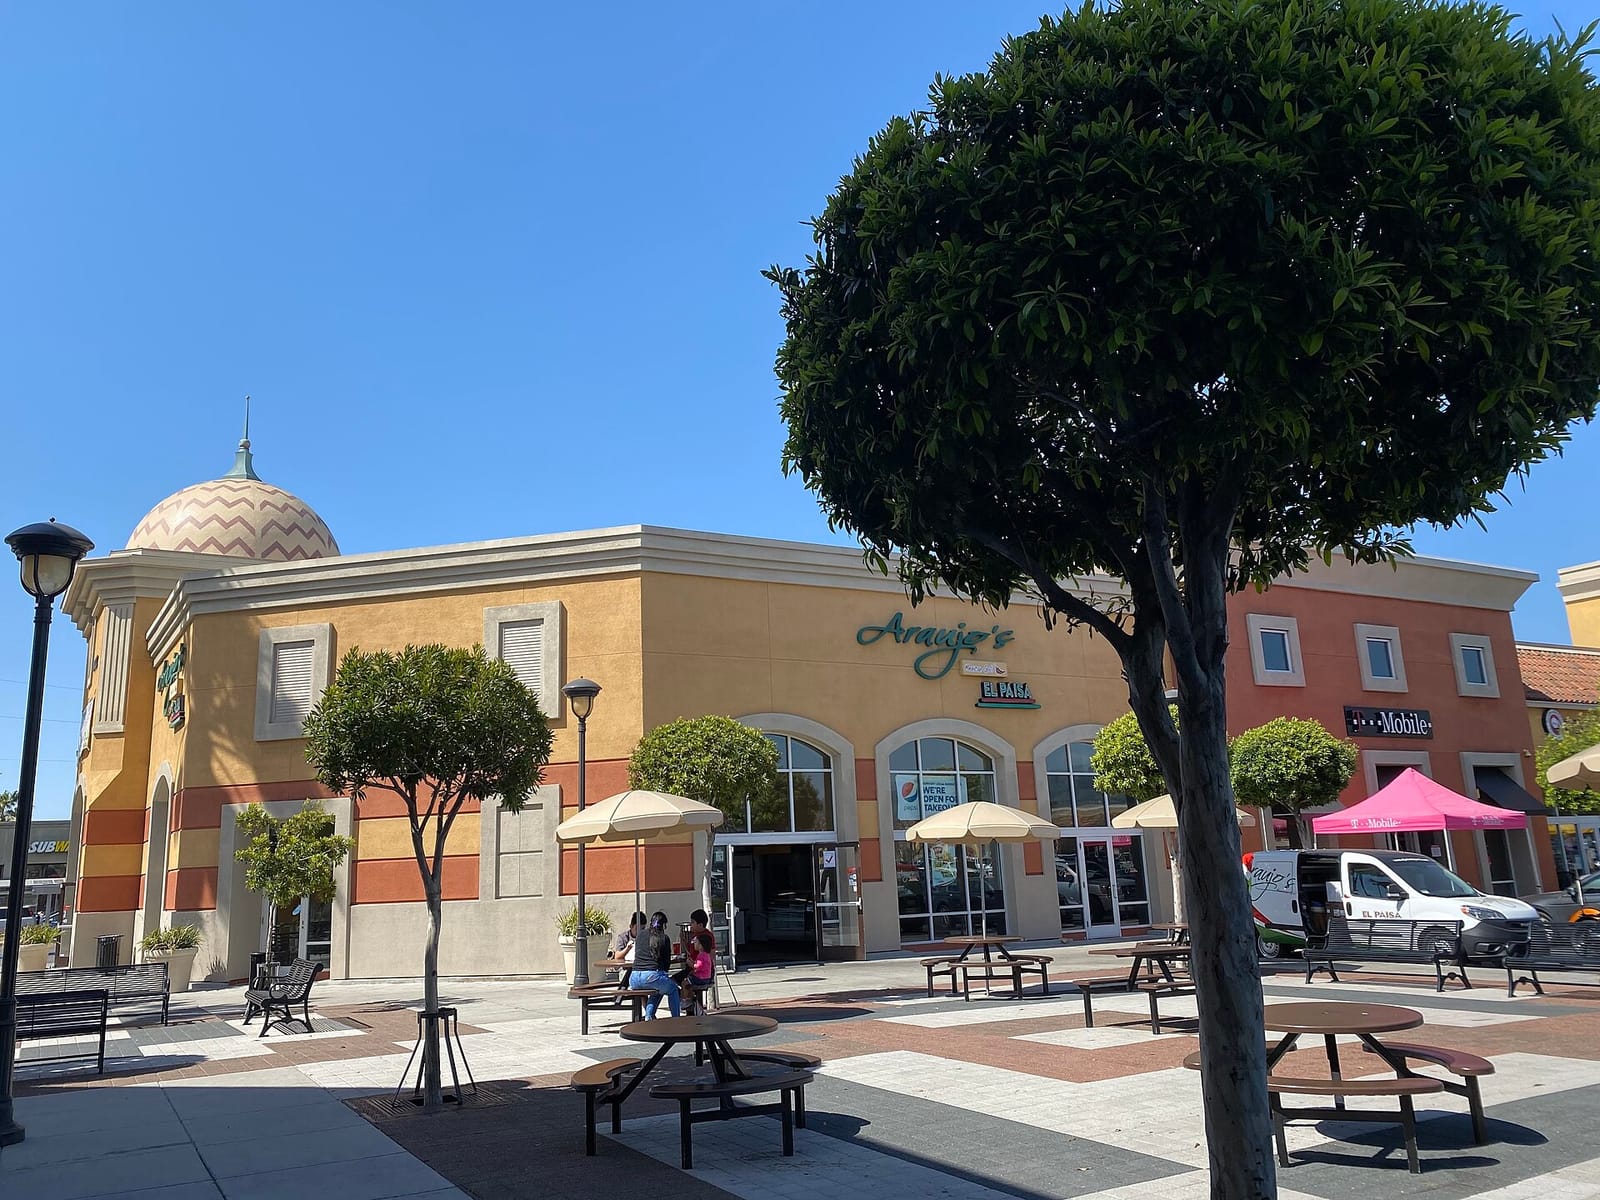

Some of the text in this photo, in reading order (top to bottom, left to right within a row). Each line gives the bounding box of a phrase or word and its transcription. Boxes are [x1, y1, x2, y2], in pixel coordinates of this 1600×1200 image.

[856, 611, 1015, 681] Araujo's
[983, 681, 1033, 699] EL PAISA
[28, 840, 69, 854] SUBW
[1250, 867, 1296, 902] raujo's
[1362, 910, 1402, 919] EL PAISA
